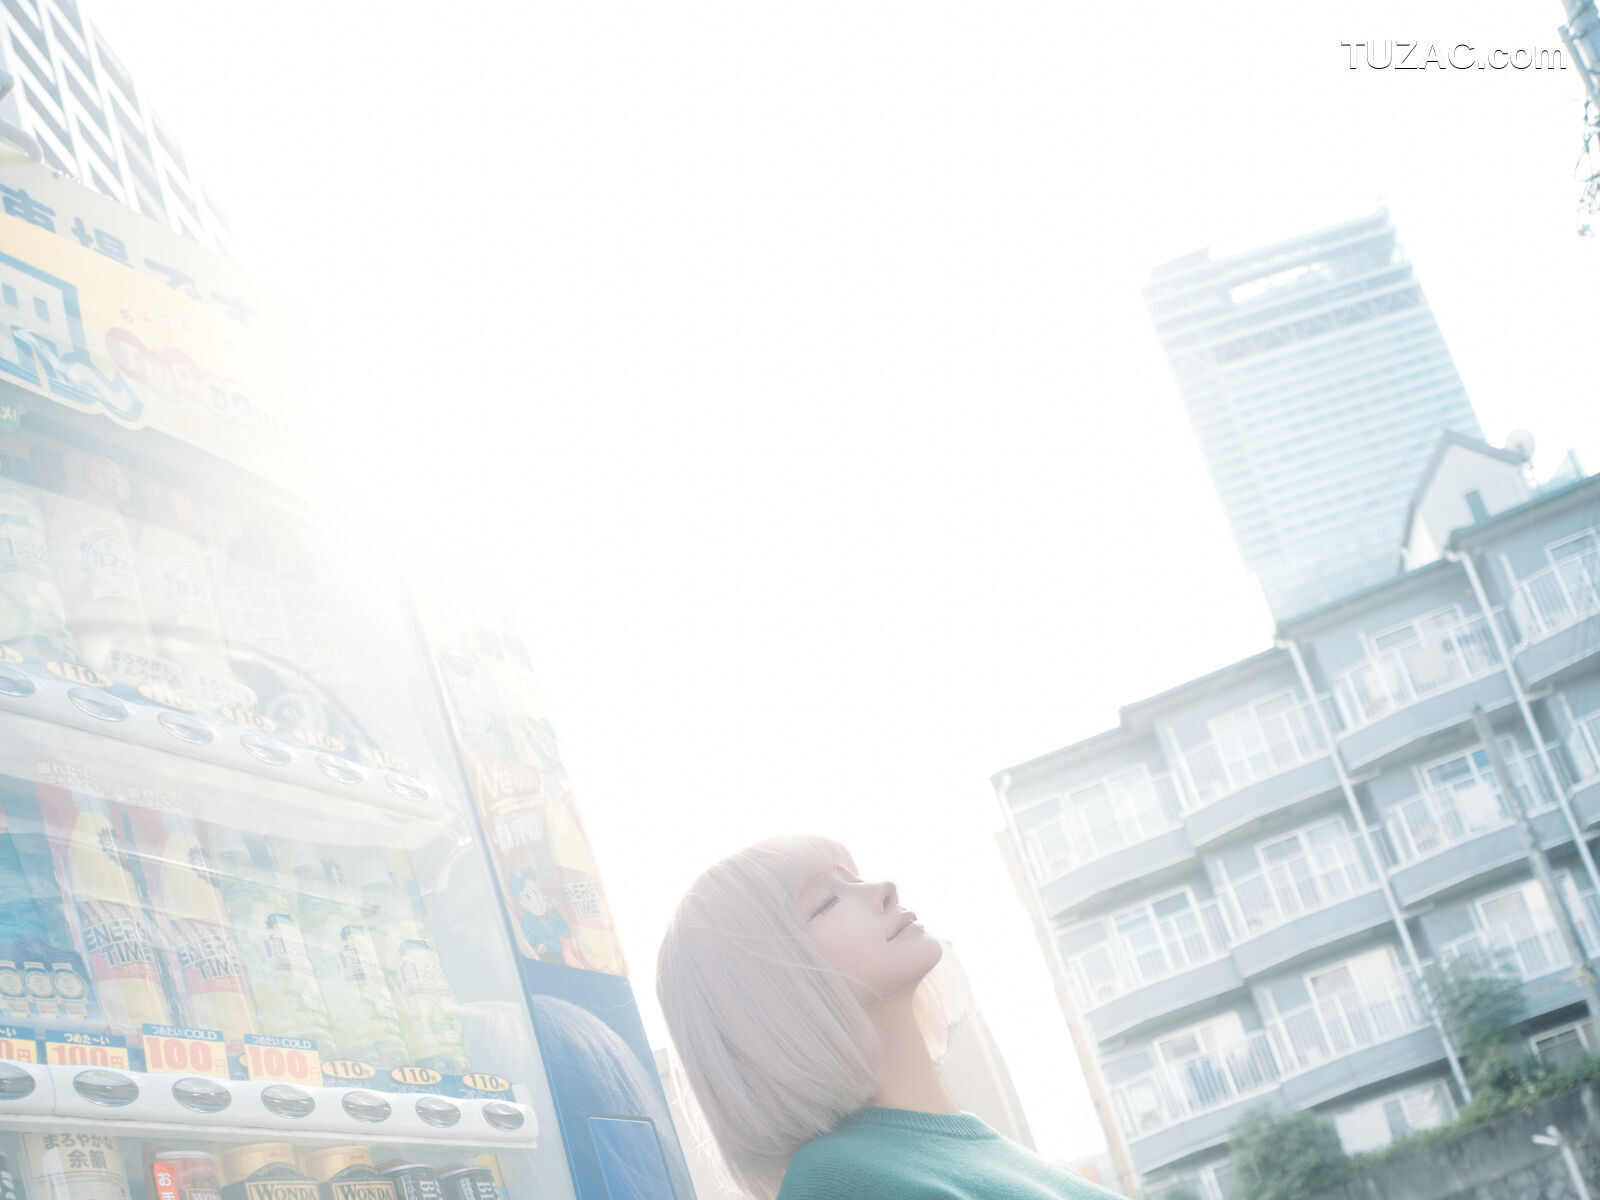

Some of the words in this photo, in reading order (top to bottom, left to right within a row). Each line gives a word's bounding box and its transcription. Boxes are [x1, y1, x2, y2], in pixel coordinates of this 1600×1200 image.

[83, 919, 147, 951] ENERG
[184, 1028, 218, 1041] COLD
[281, 1038, 312, 1050] COLD
[42, 1132, 114, 1150] まろやかな
